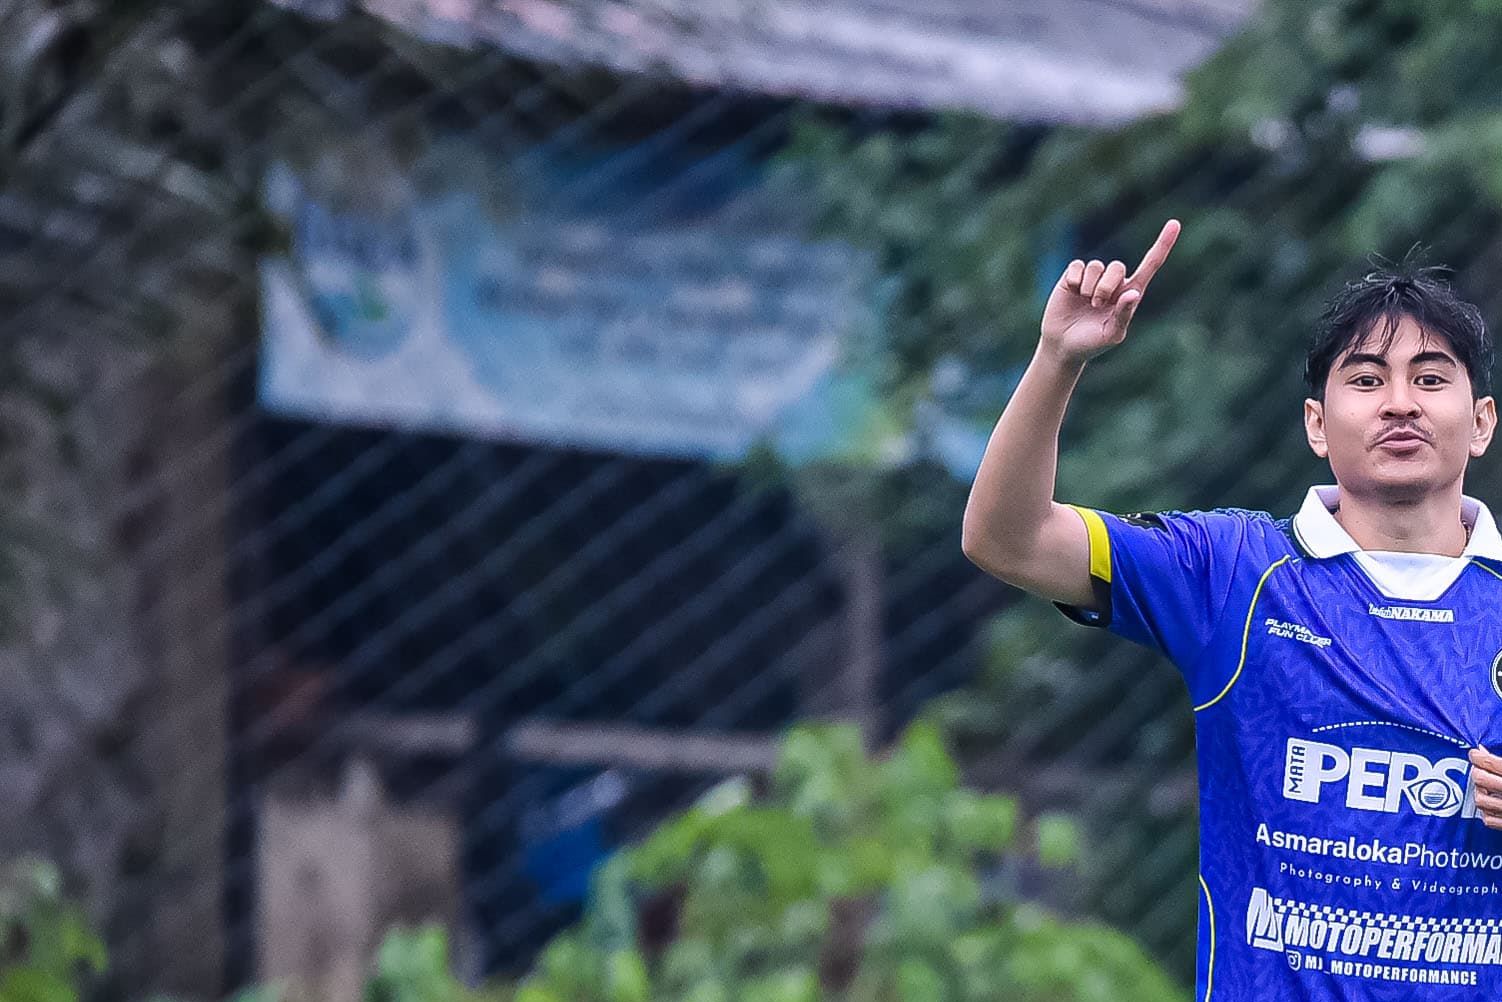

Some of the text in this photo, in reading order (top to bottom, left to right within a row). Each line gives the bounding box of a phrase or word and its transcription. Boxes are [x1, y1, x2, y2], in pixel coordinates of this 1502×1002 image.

[1283, 737, 1484, 819] MATA PERSI
[1279, 862, 1382, 890] Photography
[1391, 878, 1401, 890] &
